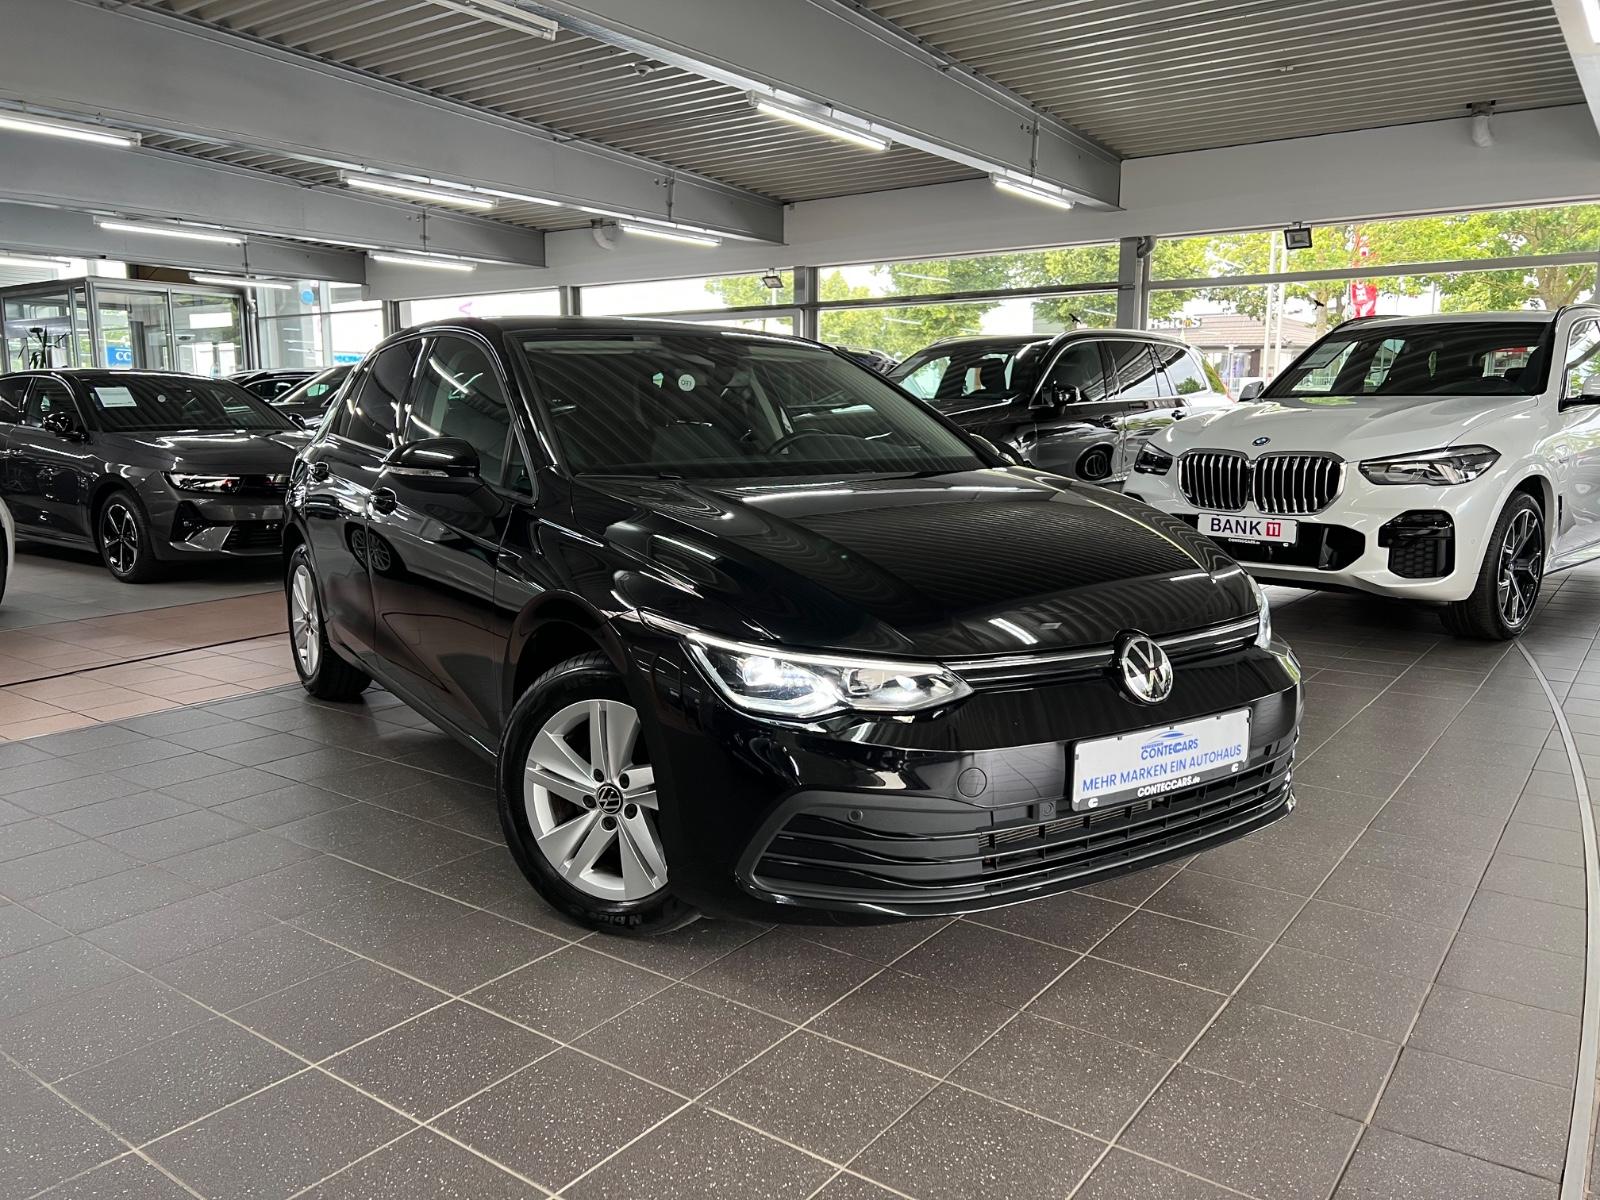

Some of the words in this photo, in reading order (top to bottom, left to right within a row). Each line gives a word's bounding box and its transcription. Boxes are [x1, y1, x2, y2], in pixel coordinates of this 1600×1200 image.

[1210, 517, 1262, 536] BANK
[1266, 523, 1281, 536] 11
[1082, 774, 1117, 792] MEHR
[1119, 762, 1168, 785] MARKEN
[1170, 758, 1187, 773] EIN
[1189, 744, 1242, 768] AUTOHAUS
[1137, 775, 1201, 797] CONTECCARS.de
